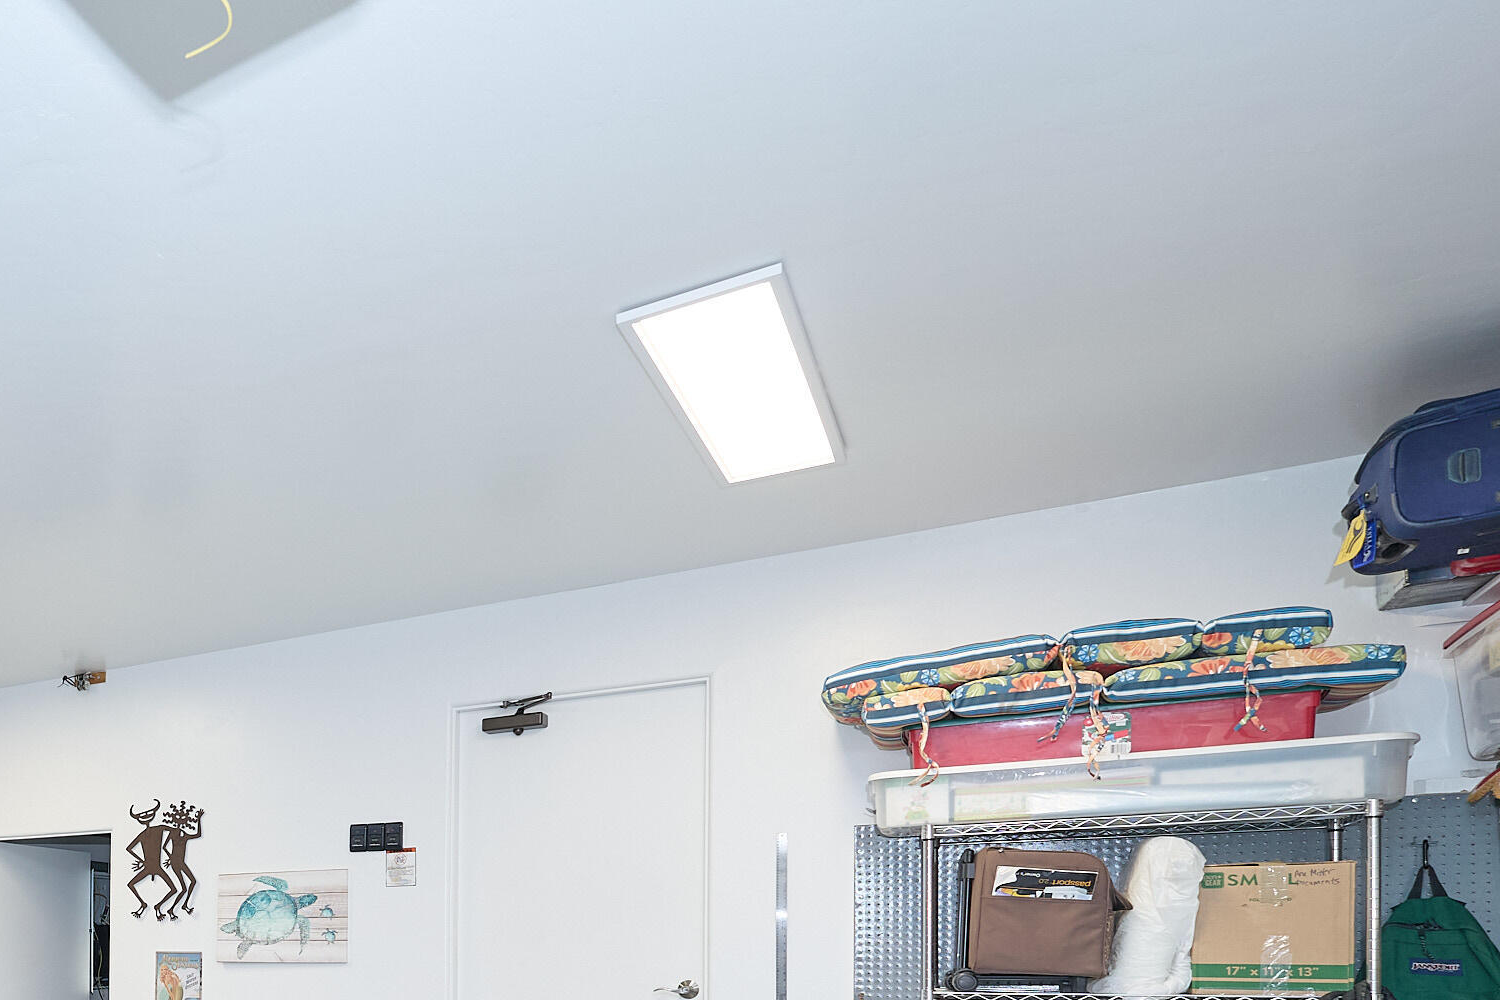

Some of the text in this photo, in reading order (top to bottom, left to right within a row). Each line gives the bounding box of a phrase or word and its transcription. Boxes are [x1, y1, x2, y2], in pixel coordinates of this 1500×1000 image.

[1051, 879, 1092, 887] passport
[1227, 873, 1299, 886] SML
[1225, 966, 1247, 976] 17"
[1297, 967, 1320, 977] 13"
